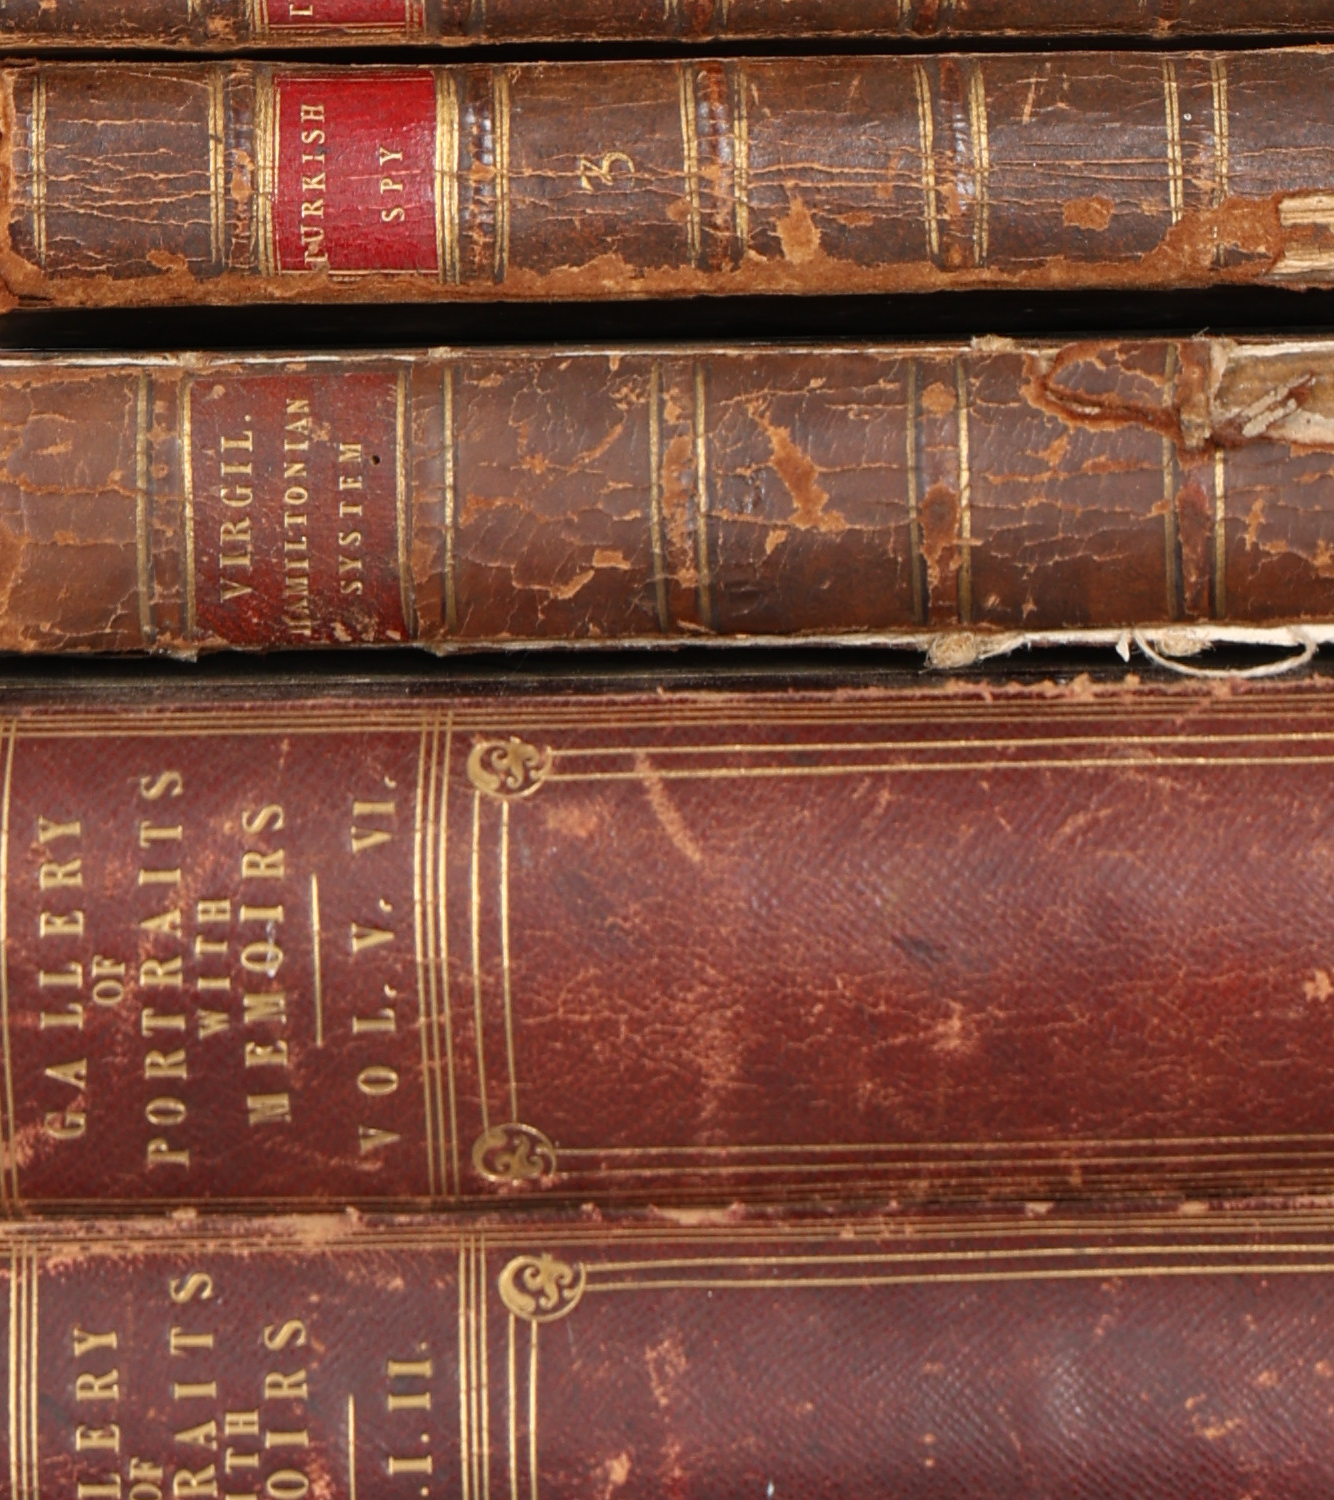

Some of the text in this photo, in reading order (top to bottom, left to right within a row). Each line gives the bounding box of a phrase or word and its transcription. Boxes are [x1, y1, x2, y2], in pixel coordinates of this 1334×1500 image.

[300, 102, 329, 264] TURKISH
[379, 145, 405, 222] SPY
[580, 151, 636, 191] 3
[219, 414, 253, 603] VIRGIL.
[283, 398, 312, 636] HAMILTONIAN
[338, 442, 363, 595] SYSTEM
[38, 813, 89, 1140] GALLERY
[91, 956, 125, 1007] OF
[138, 768, 191, 1169] PORTRAITS
[196, 898, 233, 1040] WITH
[240, 801, 291, 1125] MEMOIRS
